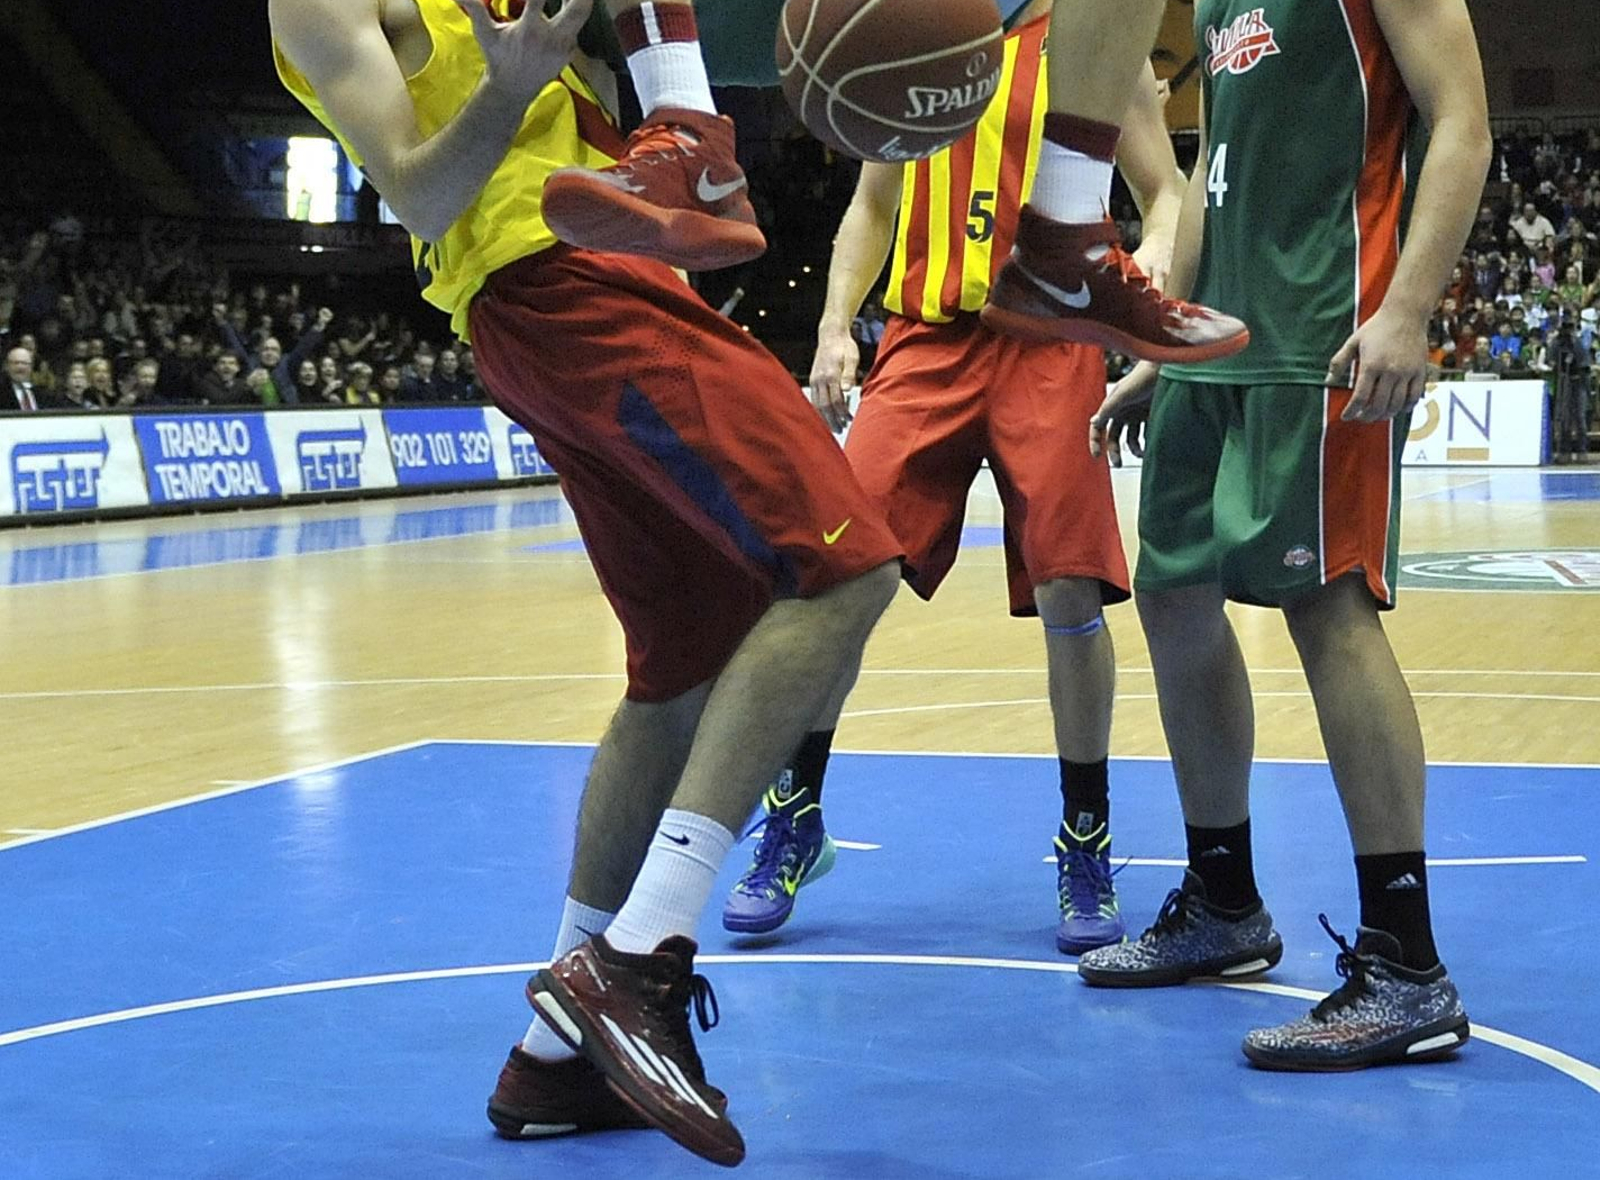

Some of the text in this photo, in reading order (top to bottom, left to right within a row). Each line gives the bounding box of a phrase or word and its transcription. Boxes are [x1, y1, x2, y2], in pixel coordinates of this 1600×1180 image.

[1204, 142, 1228, 208] 4
[966, 190, 994, 243] 5
[154, 420, 250, 458] TRABAJO
[391, 433, 427, 468] 902
[425, 432, 458, 466] 101
[459, 431, 490, 465] 329
[154, 461, 270, 500] TEMPORAL
